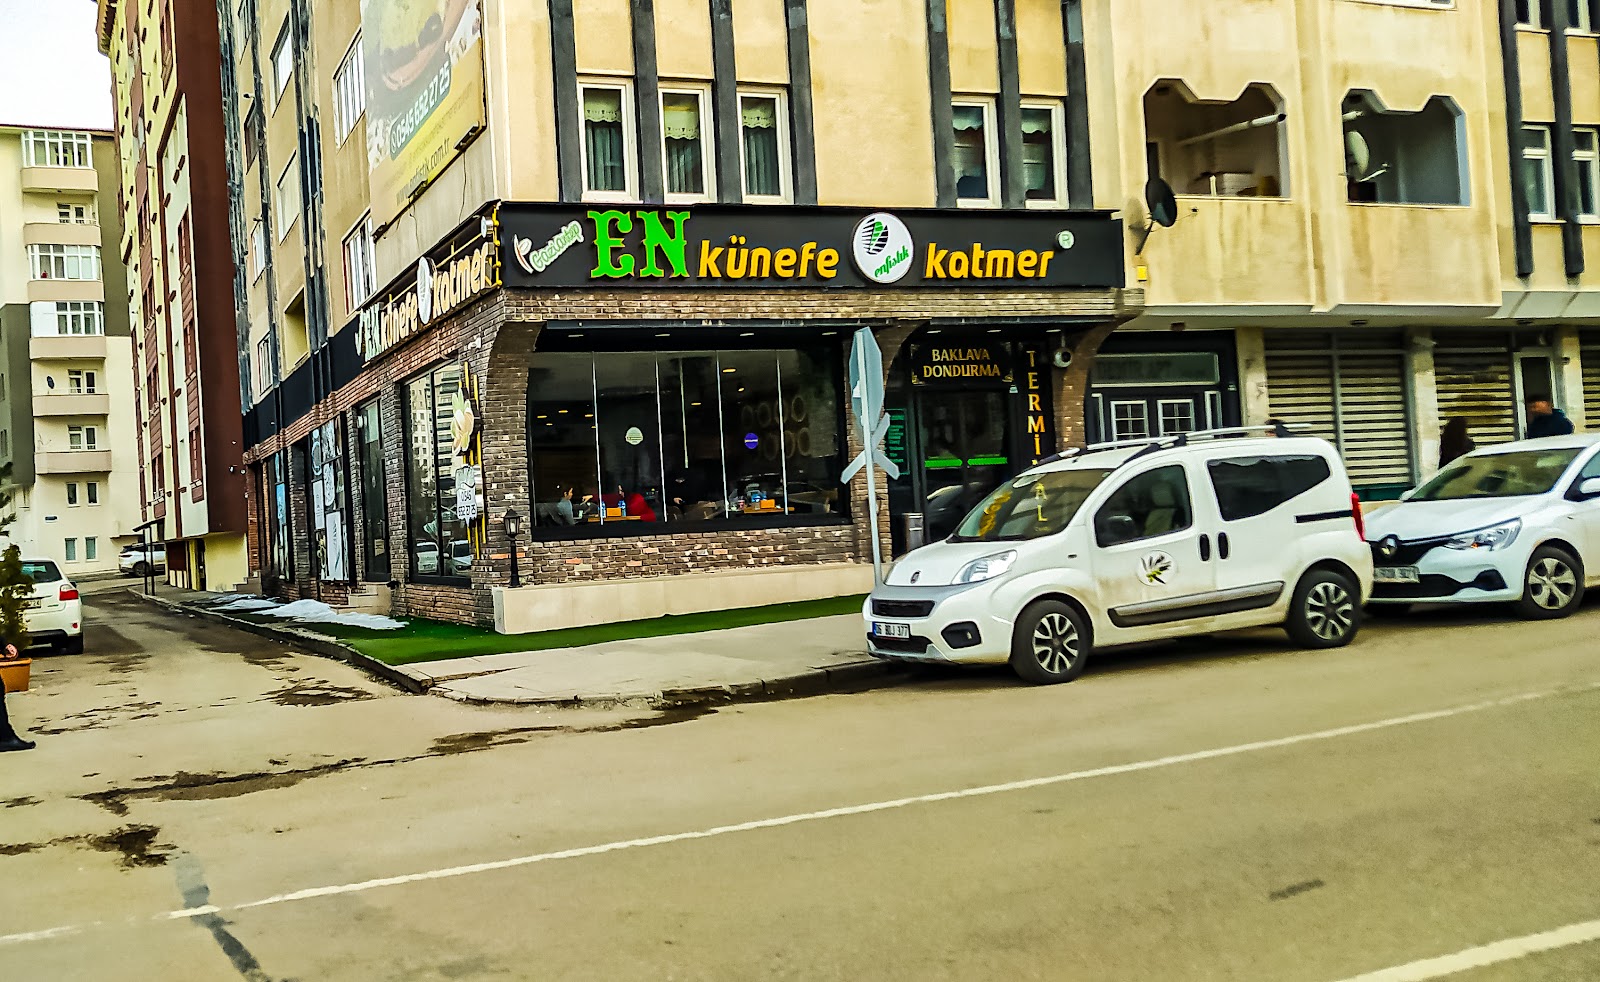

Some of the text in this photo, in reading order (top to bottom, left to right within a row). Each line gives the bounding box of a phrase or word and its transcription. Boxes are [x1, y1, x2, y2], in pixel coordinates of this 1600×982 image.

[414, 88, 429, 127] 652
[429, 74, 439, 108] 27
[440, 60, 450, 96] 25
[587, 209, 840, 279] EN künefe
[924, 242, 1054, 279] katmer
[433, 242, 489, 319] katmer
[923, 364, 1000, 378] DONDURMA
[931, 348, 990, 362] BAKLAVA
